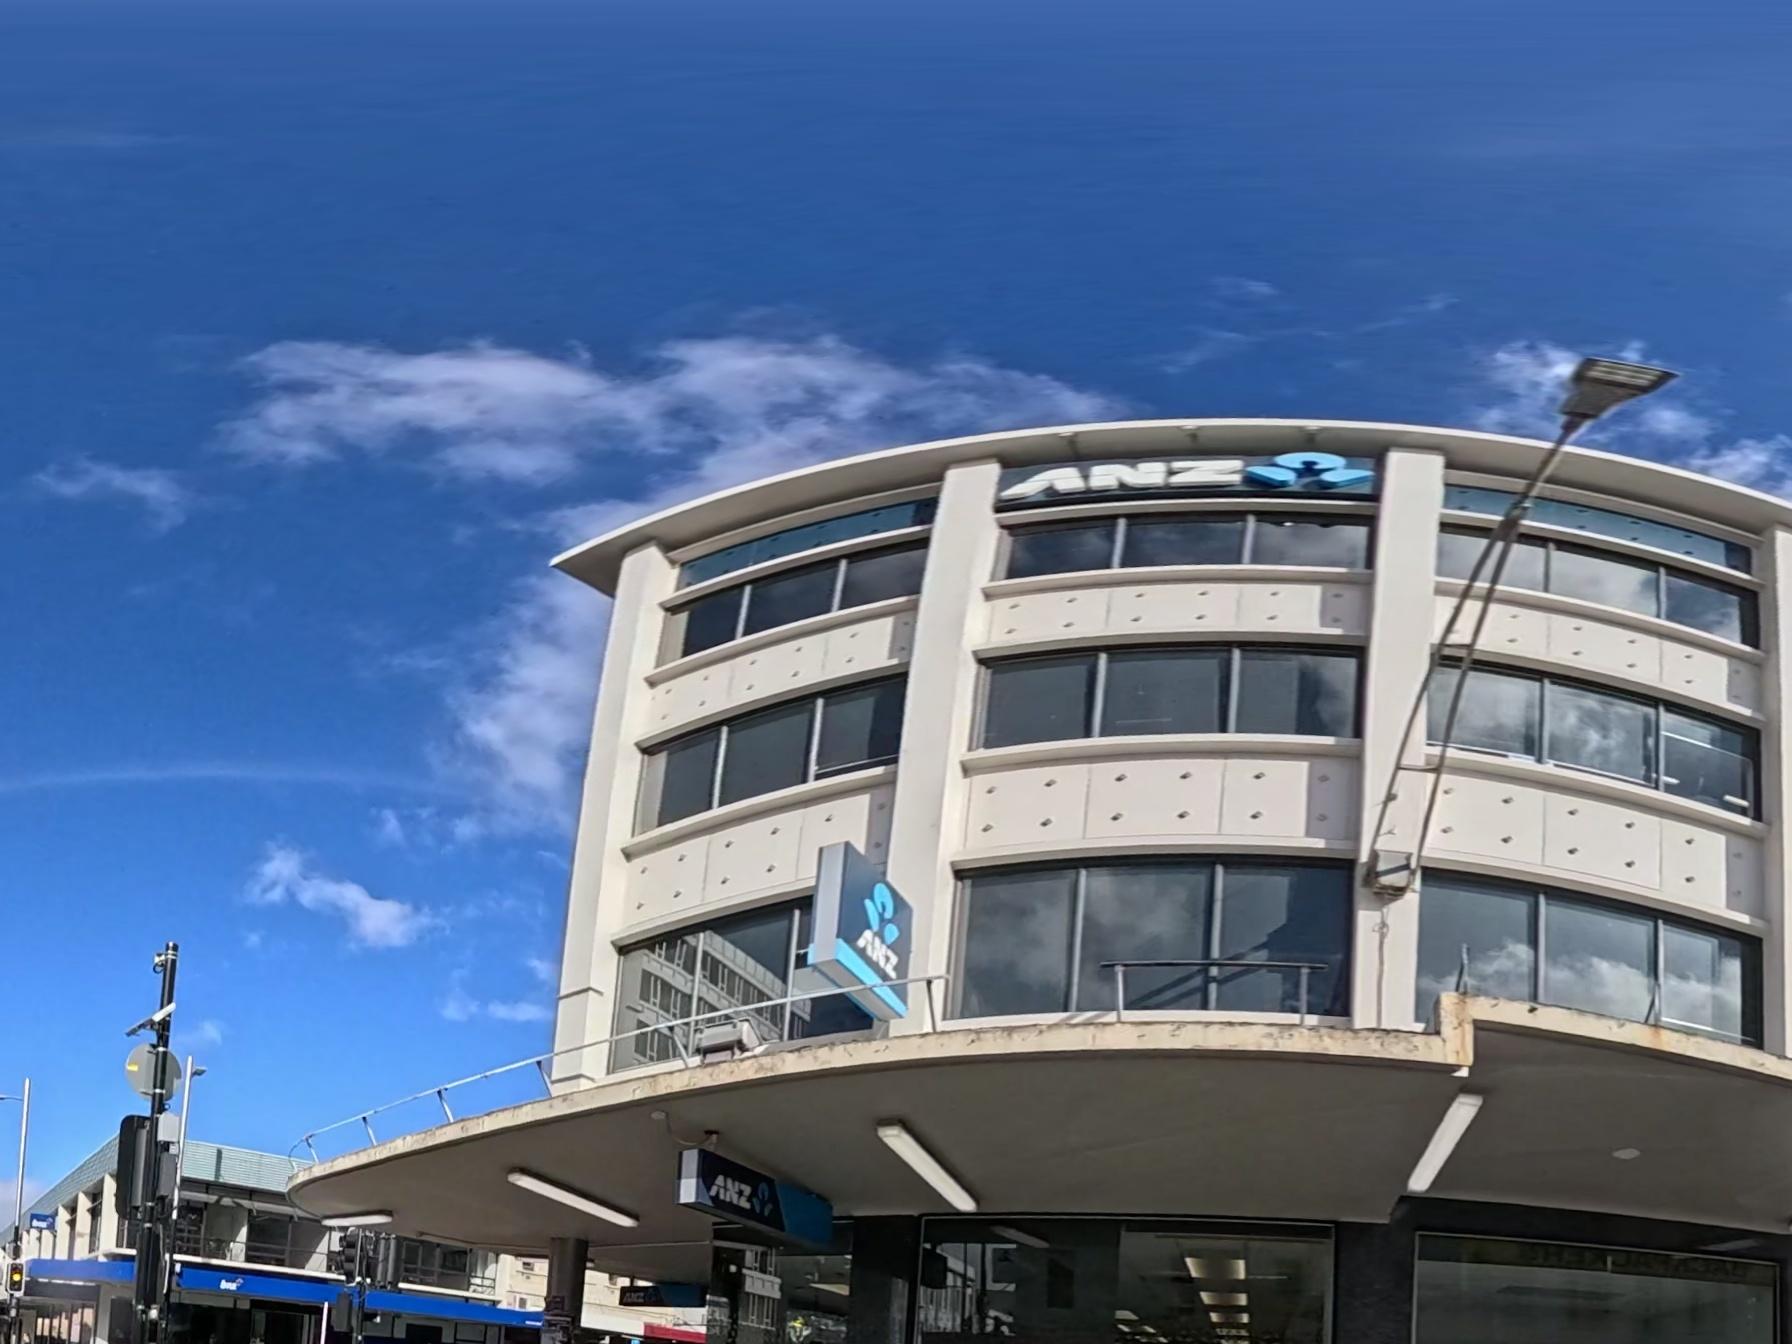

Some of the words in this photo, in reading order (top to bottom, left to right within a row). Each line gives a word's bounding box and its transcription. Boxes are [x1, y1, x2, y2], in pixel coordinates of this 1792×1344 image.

[1001, 459, 1244, 500] ANZ
[857, 929, 898, 979] ANZ
[709, 1174, 752, 1210] ANZ
[623, 1291, 645, 1304] ANZ
